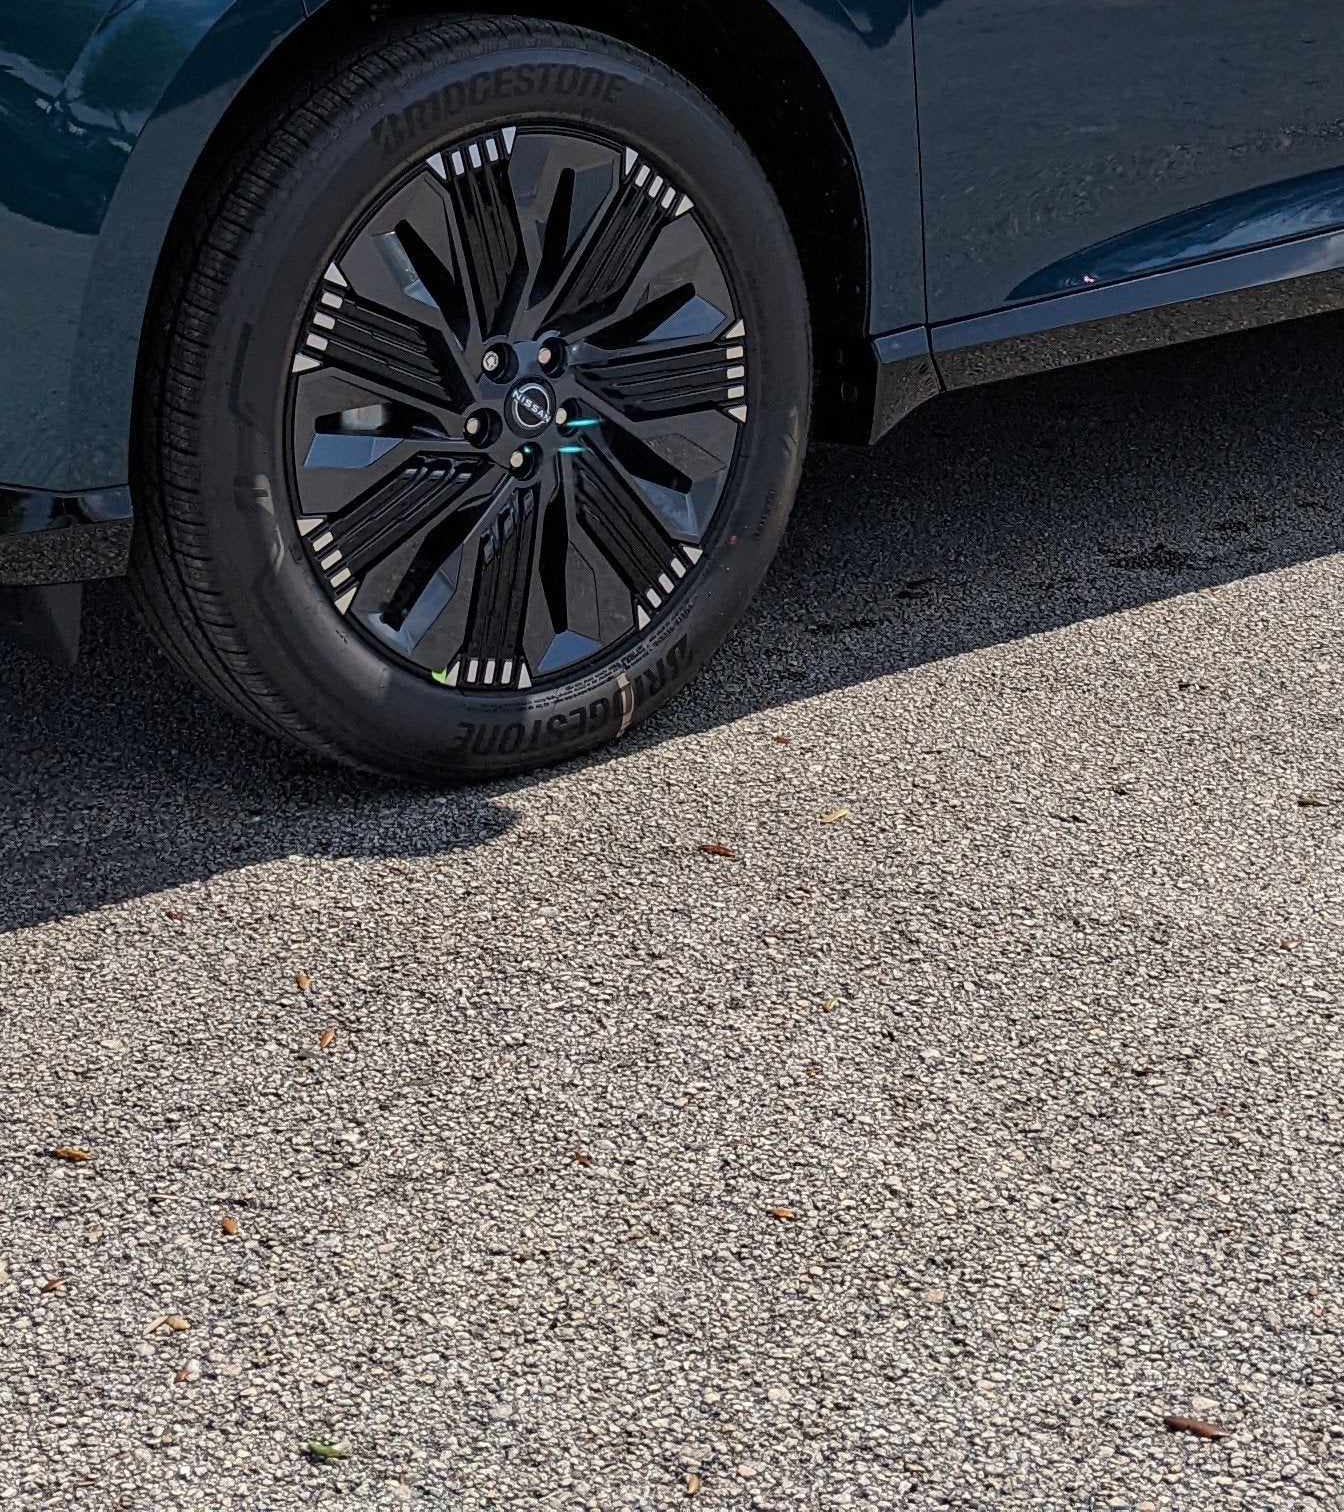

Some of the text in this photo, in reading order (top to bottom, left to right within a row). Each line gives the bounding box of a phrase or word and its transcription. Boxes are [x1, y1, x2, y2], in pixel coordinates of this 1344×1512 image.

[371, 63, 628, 144] BRIDGESTONE
[512, 390, 551, 423] NISSAN
[457, 633, 694, 755] BRIDGESTONE
